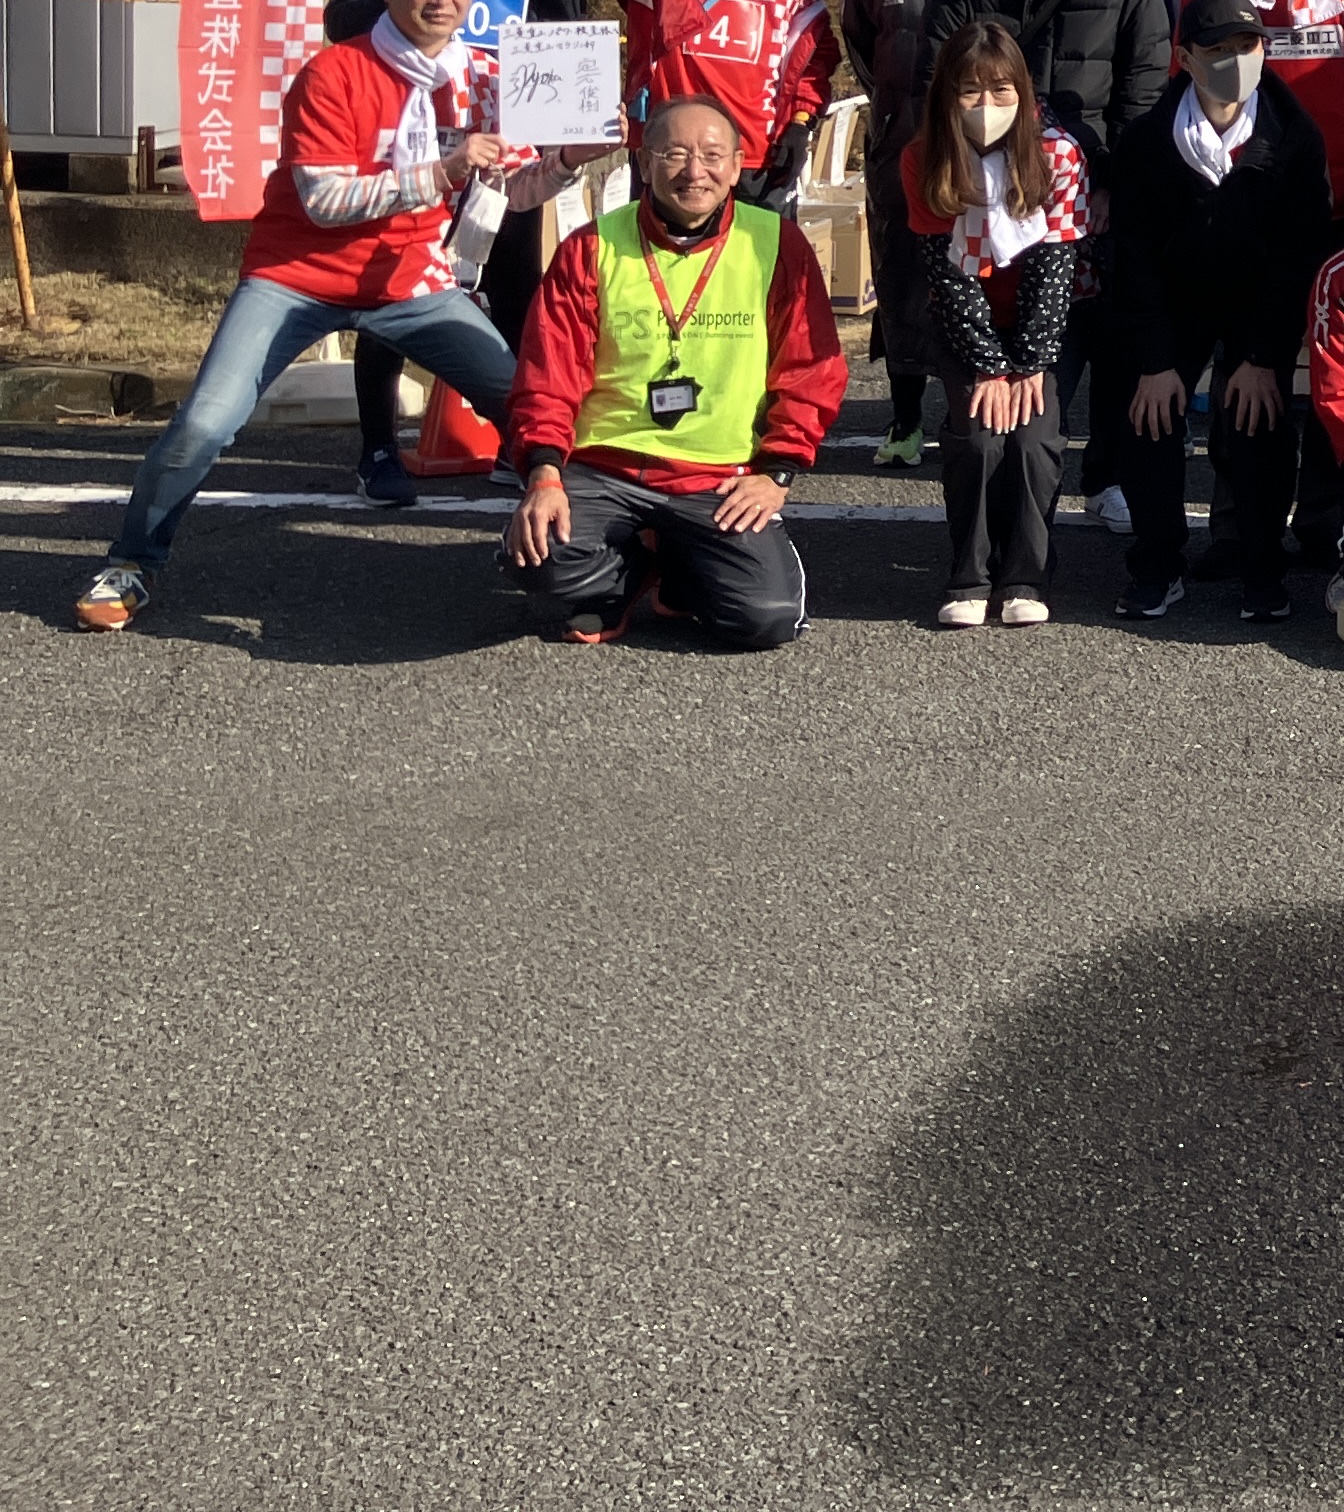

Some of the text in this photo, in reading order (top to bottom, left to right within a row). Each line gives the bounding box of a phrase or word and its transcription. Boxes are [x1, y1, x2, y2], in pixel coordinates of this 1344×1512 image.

[1274, 31, 1337, 46] 三菱重工
[690, 309, 756, 330] Supporter
